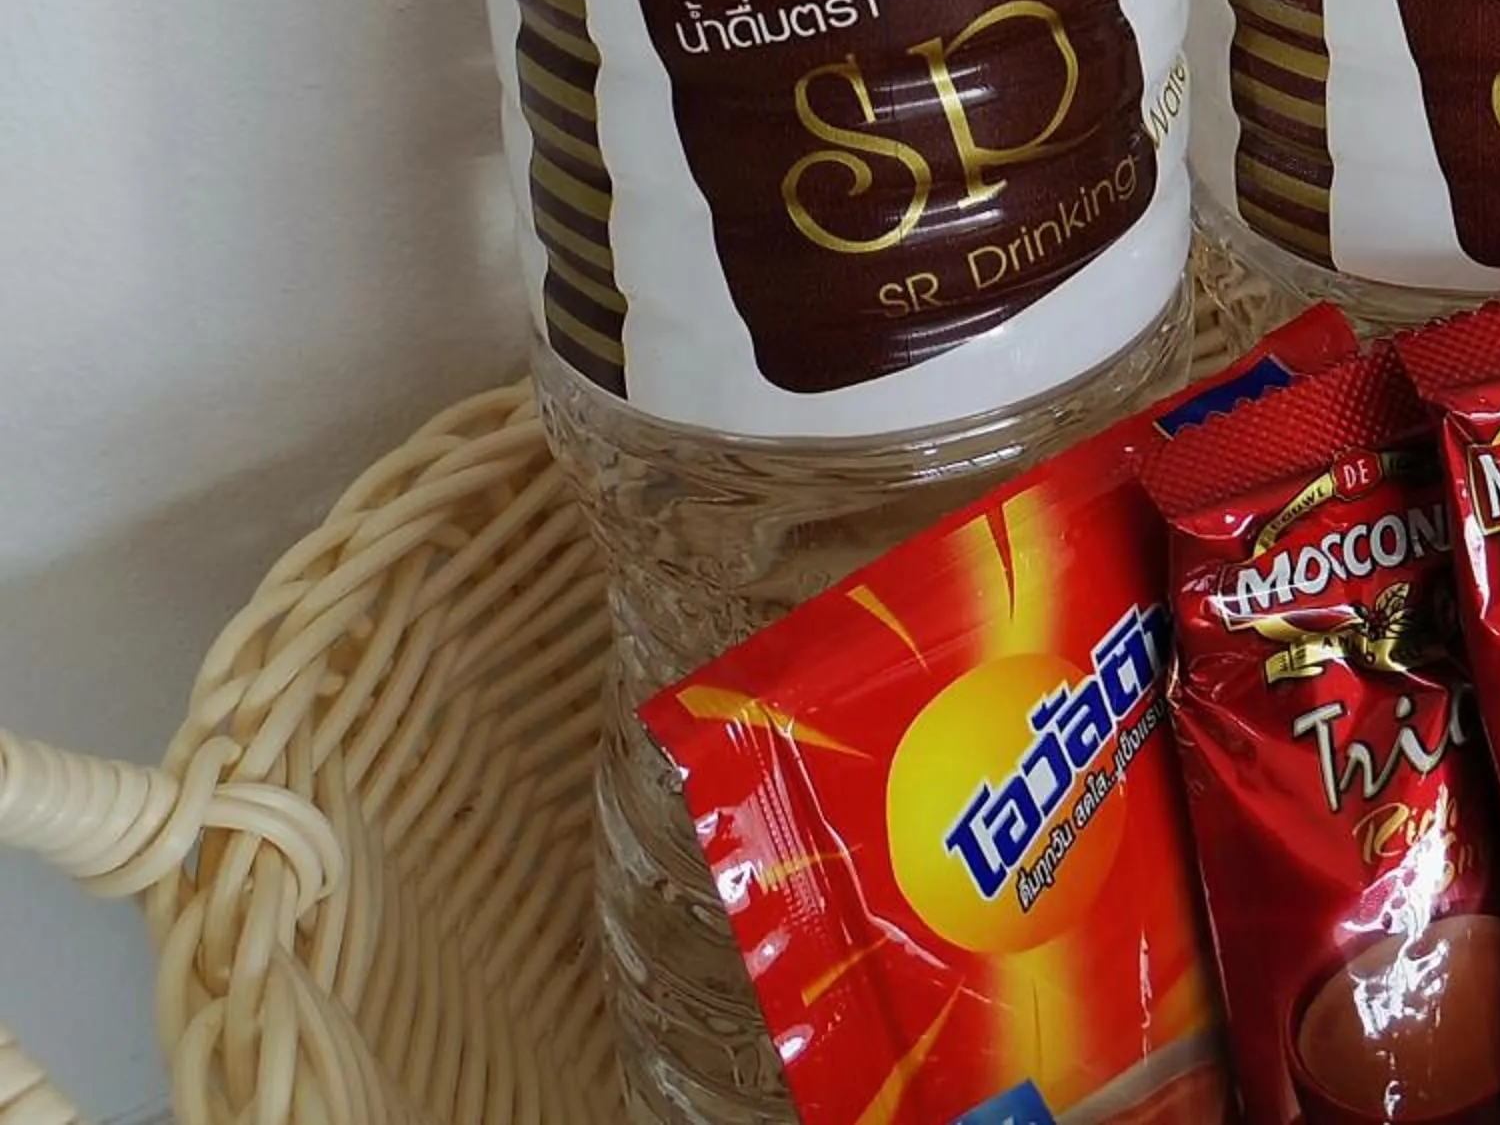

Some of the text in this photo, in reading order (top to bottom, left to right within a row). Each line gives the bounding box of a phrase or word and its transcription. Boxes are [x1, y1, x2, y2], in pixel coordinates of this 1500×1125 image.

[879, 274, 953, 318] SR
[967, 154, 1139, 289] Drinking
[1342, 458, 1371, 490] DE
[1235, 503, 1452, 617] MOCCON
